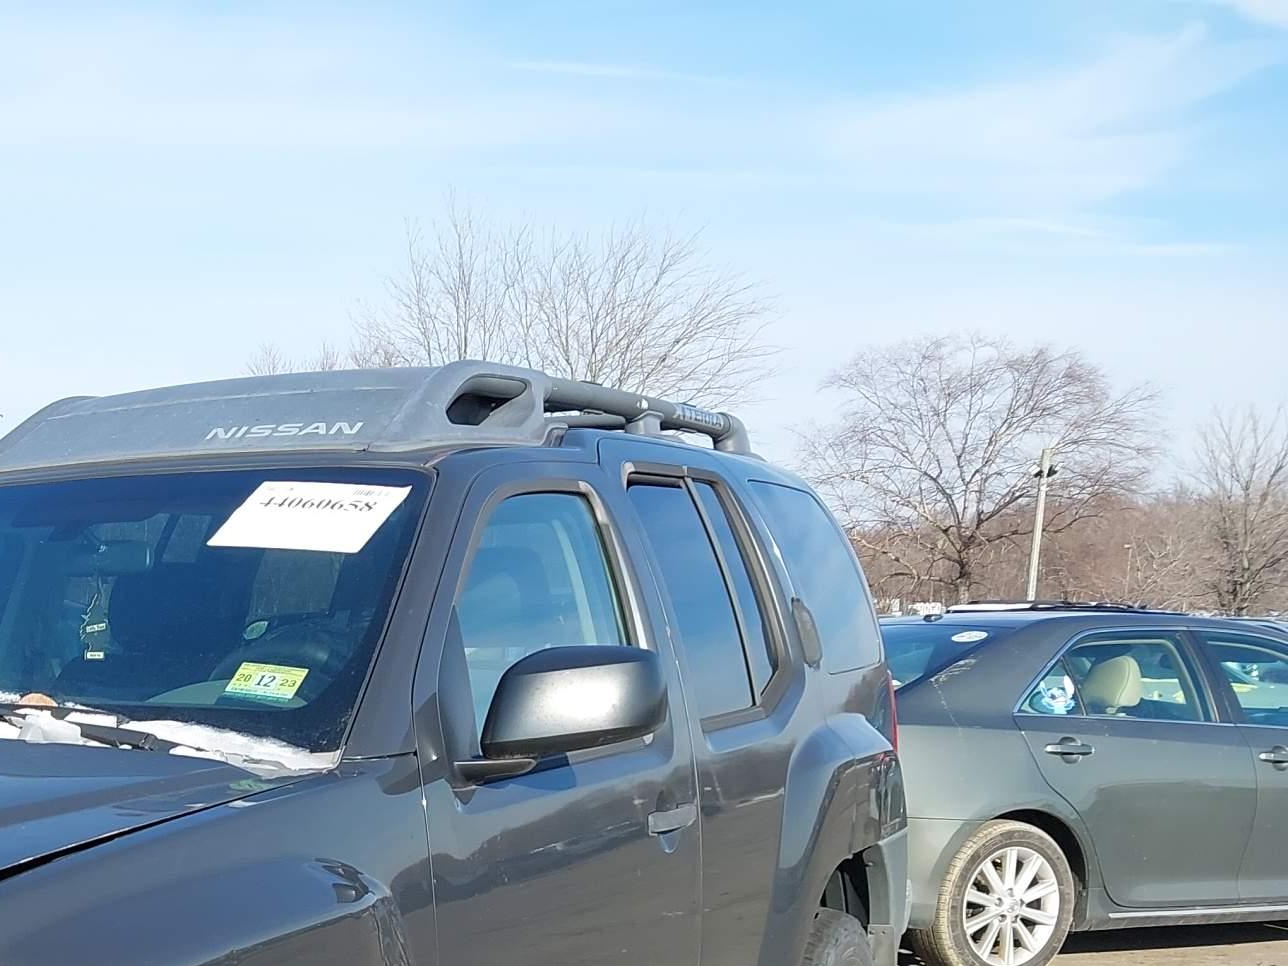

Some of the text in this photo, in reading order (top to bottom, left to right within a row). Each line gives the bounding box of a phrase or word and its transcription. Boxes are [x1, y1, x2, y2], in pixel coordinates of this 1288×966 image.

[205, 421, 364, 440] NISSAN
[259, 496, 378, 512] 44060658
[236, 673, 297, 688] 20 12 23
